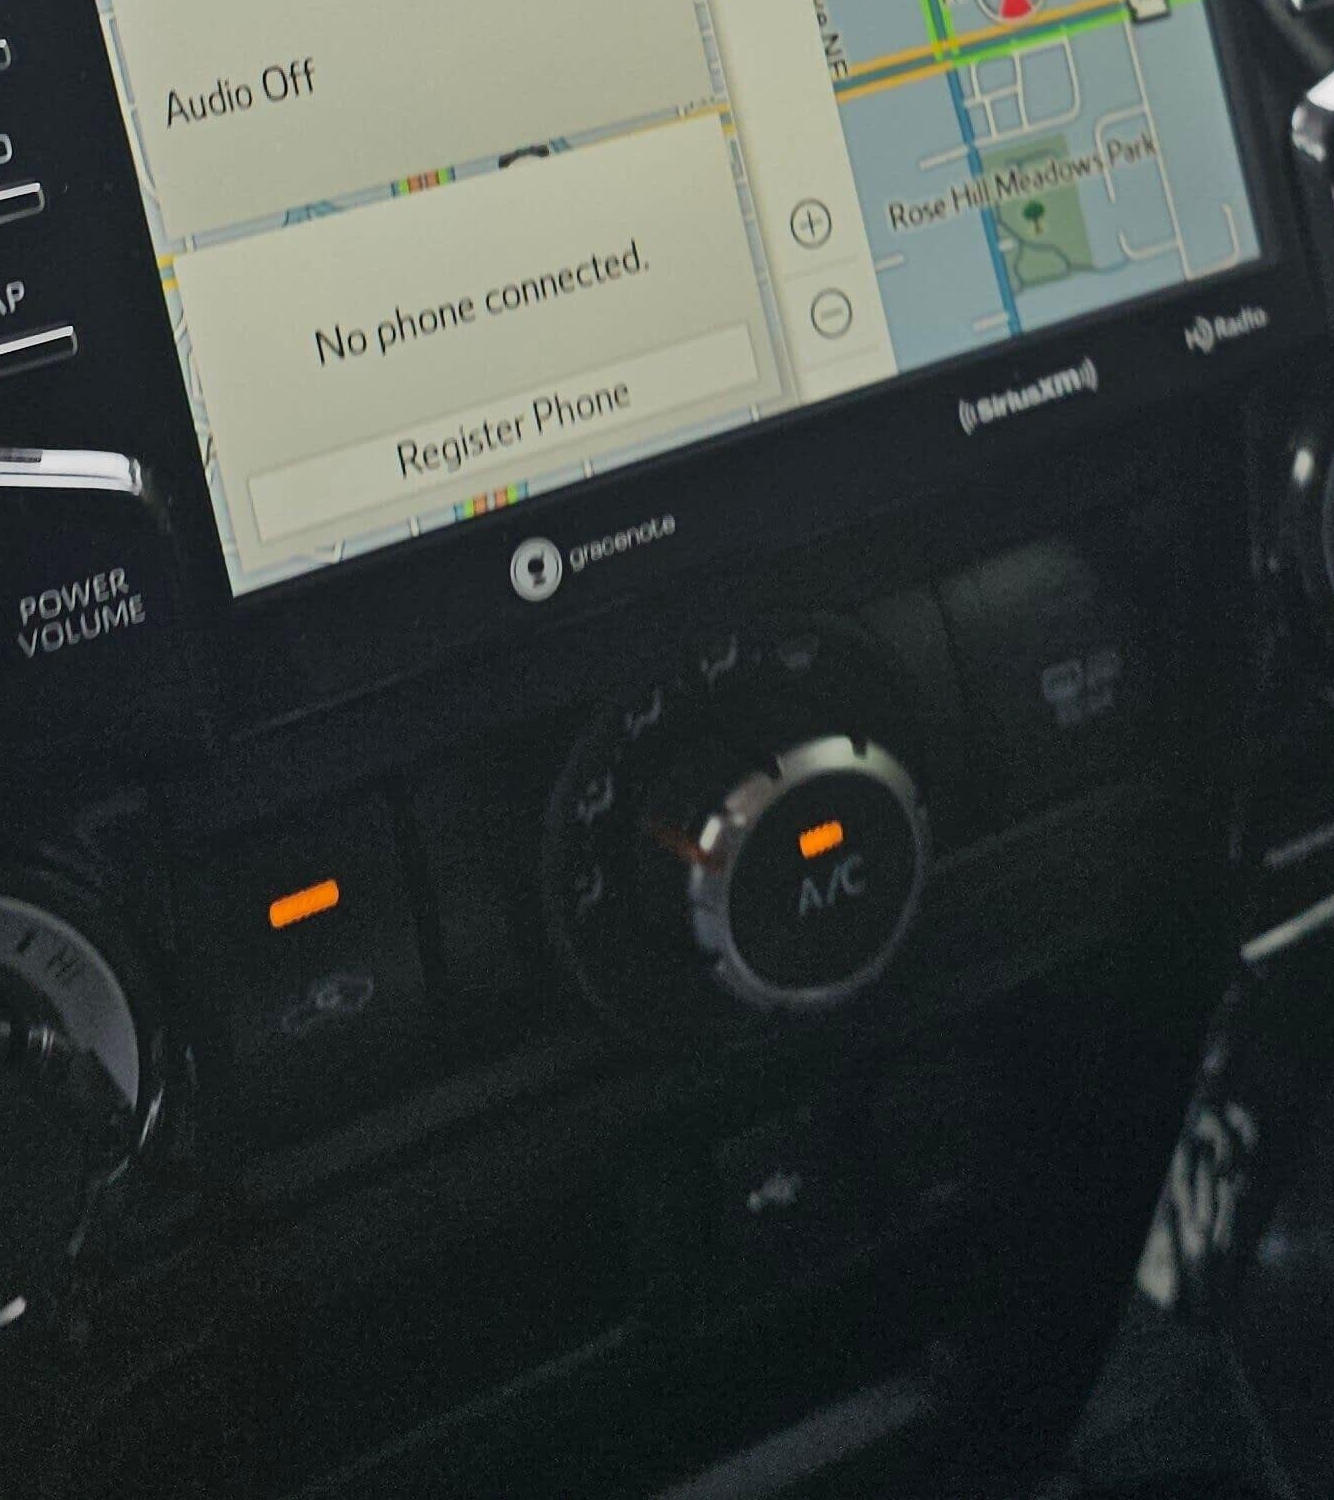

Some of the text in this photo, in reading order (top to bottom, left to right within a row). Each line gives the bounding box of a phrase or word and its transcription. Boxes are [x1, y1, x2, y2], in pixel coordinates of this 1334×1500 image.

[167, 56, 315, 130] Audio Off
[888, 131, 1157, 231] Rose Hill Meadows Park
[314, 239, 650, 367] No phone connected.
[1214, 306, 1268, 340] Radio
[396, 379, 632, 478] Register Phone
[569, 513, 676, 573] gracenote
[17, 593, 146, 659] VOLUME
[20, 567, 130, 628] POWER
[798, 853, 864, 917] A/C
